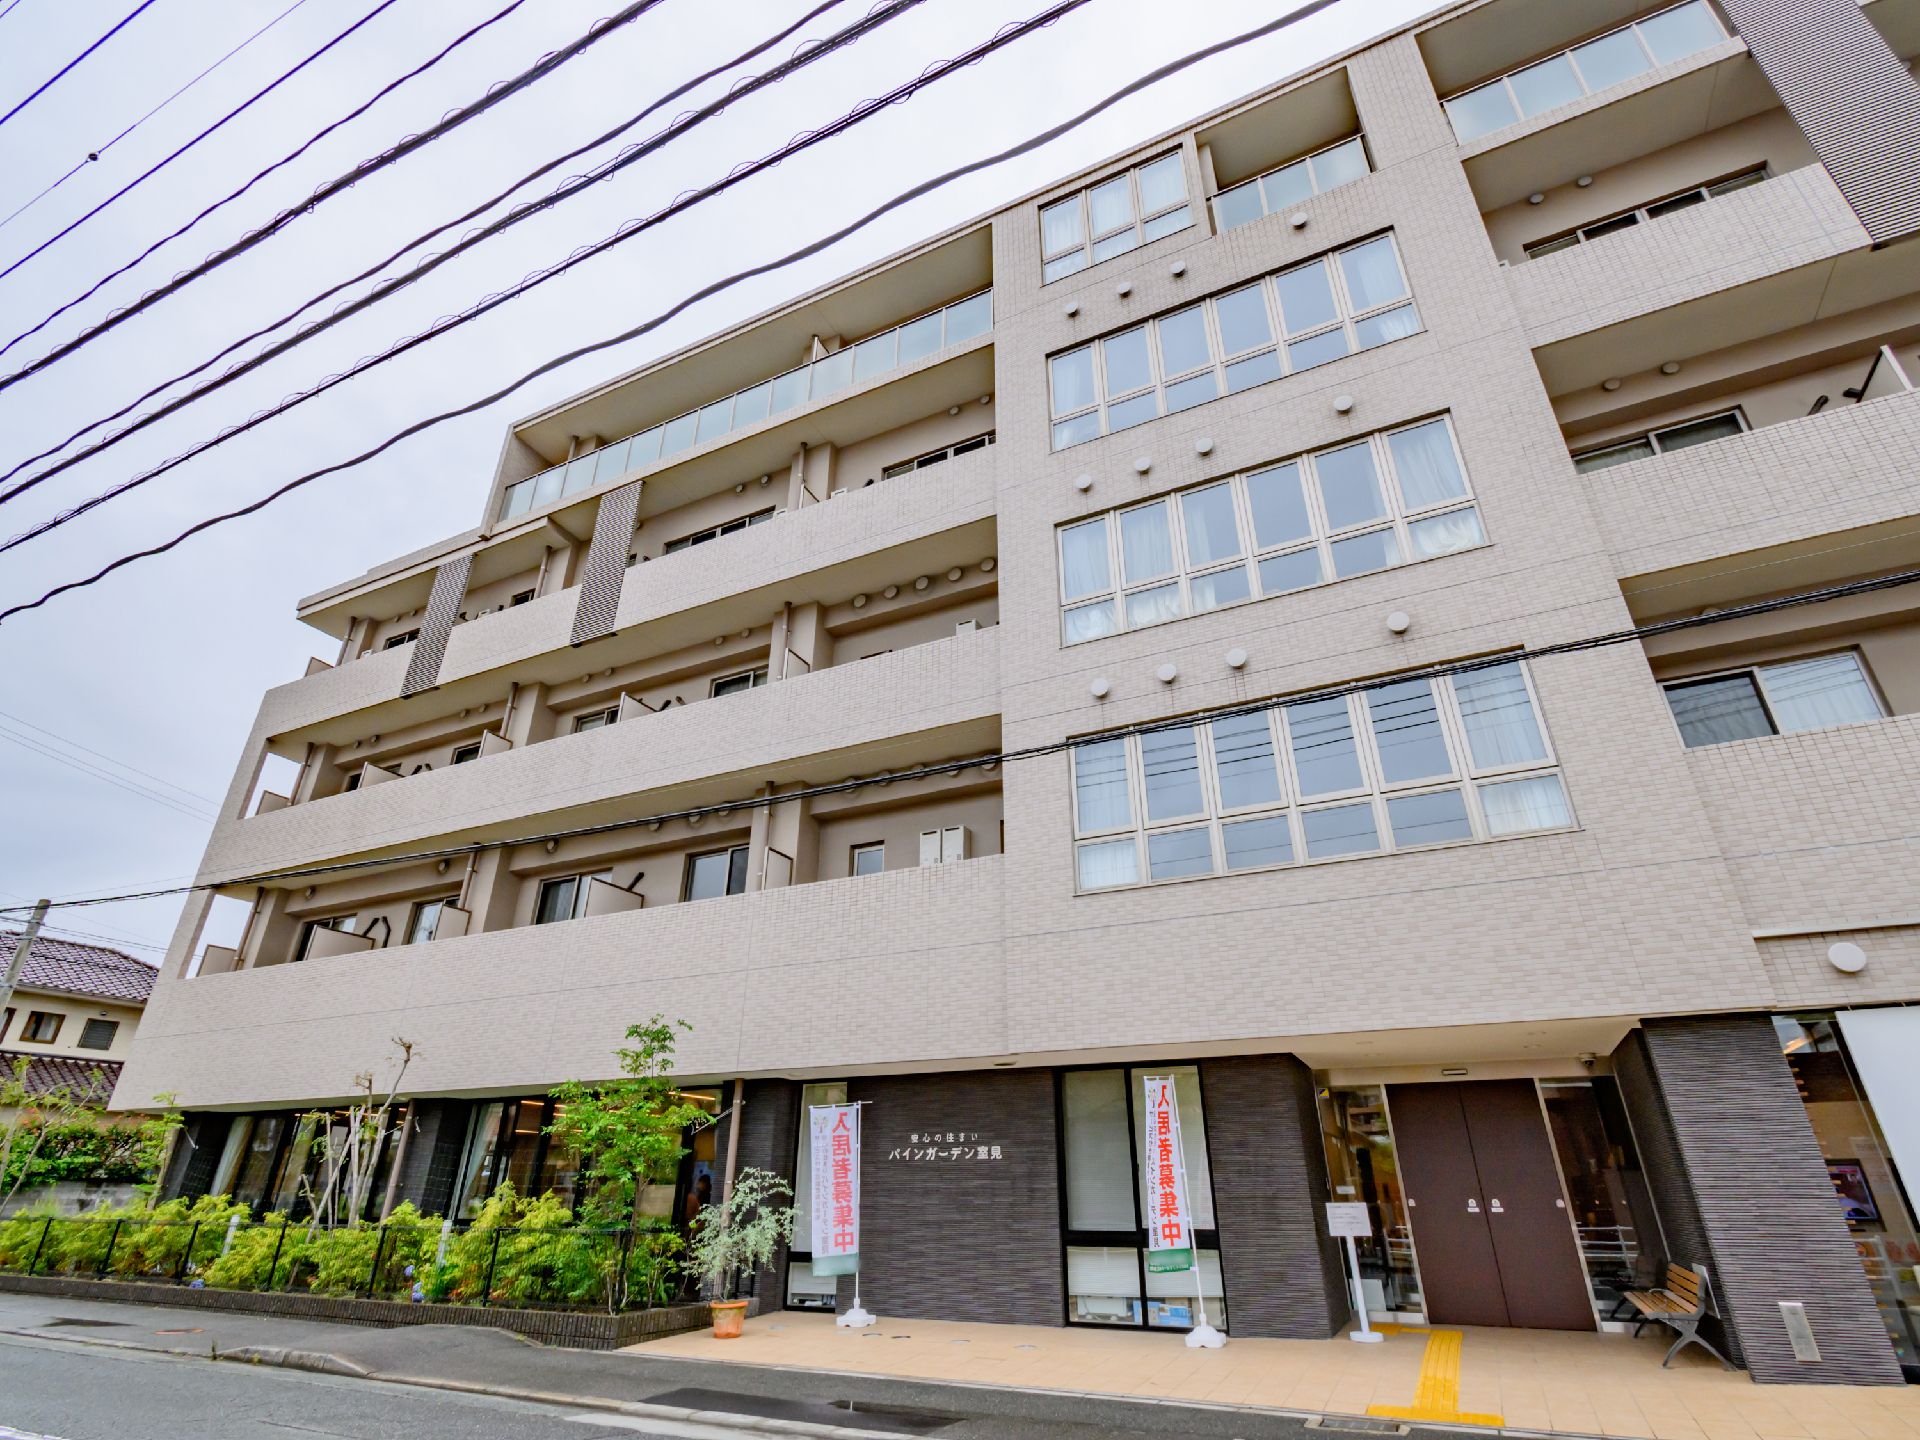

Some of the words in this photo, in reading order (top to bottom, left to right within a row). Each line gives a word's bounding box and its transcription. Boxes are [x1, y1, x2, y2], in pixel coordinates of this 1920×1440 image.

[910, 1132, 978, 1143] 安心の住まい
[888, 1145, 1003, 1160] パインガーデン室見
